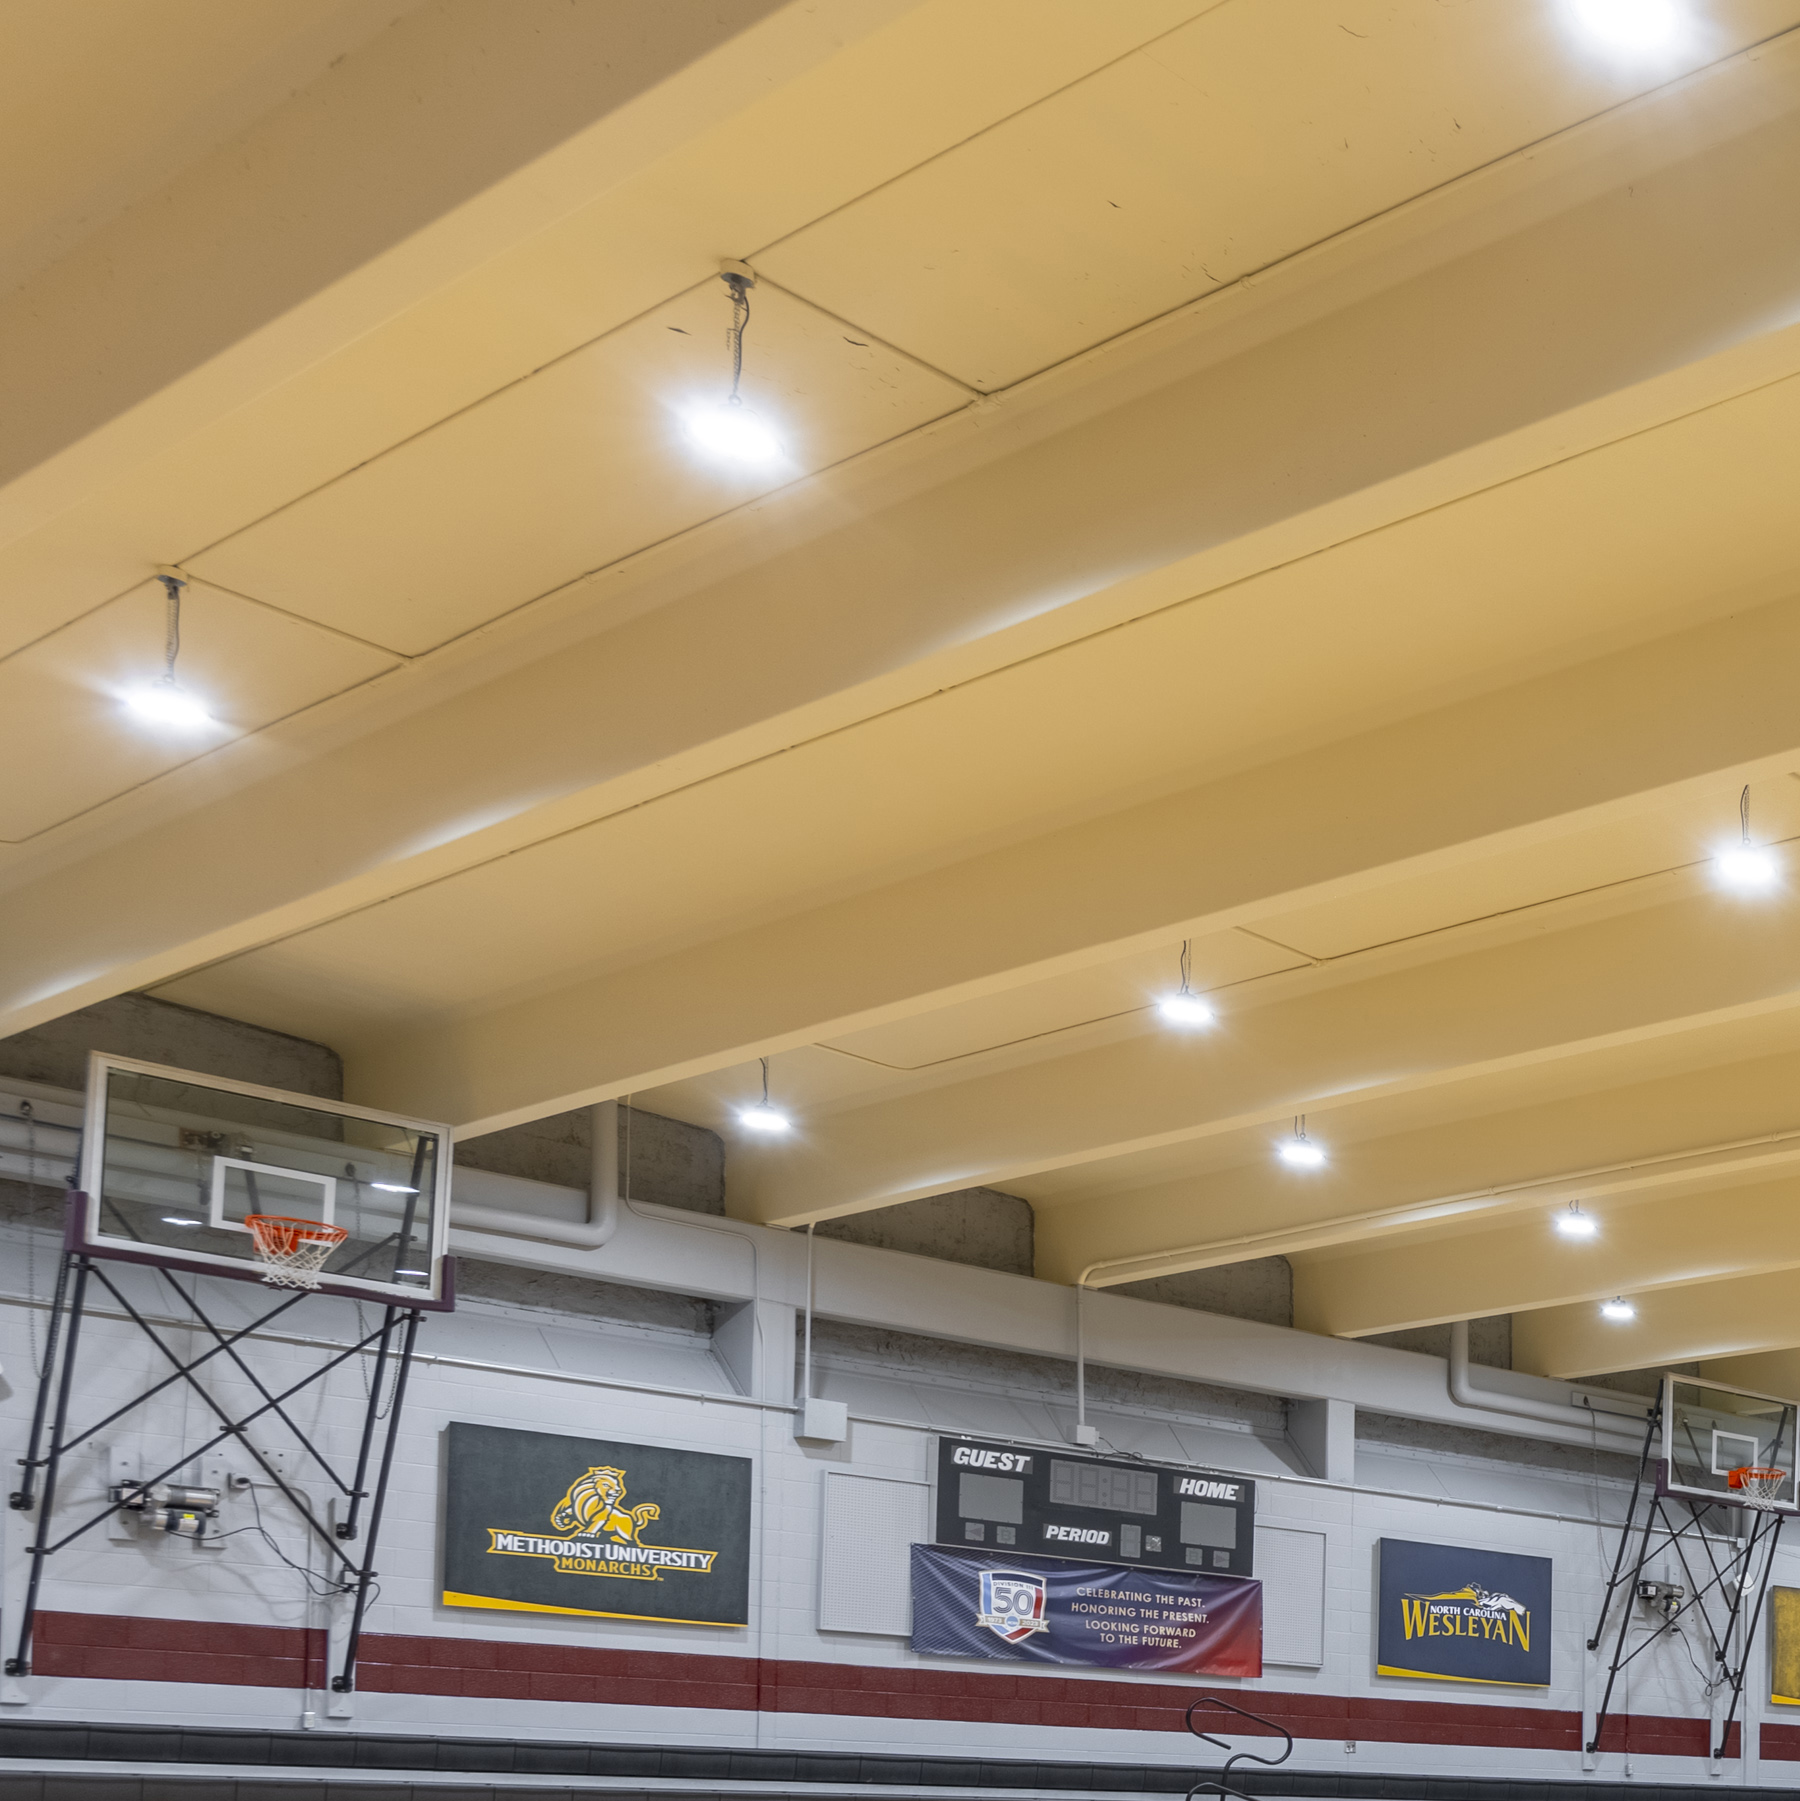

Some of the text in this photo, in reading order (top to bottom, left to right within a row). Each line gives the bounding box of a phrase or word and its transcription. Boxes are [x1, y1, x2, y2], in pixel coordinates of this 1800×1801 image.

[954, 1447, 1031, 1472] GUEST
[1179, 1478, 1240, 1501] HOME
[1045, 1525, 1110, 1545] PERIOD
[496, 1532, 711, 1569] METHODIST UNIVERSITY
[561, 1557, 651, 1576] MONARCHS
[993, 1586, 1034, 1616] 50
[1076, 1586, 1206, 1608] CELEBRATING THE PAST.
[1071, 1602, 1210, 1624] HONORING THE PRESENT.
[1430, 1605, 1507, 1621] NORTH CAROLINA
[1085, 1620, 1196, 1638] LOOKING FORWARD
[1401, 1598, 1530, 1652] WESLEYAN
[1100, 1633, 1182, 1649] TO THE FUTURE.
